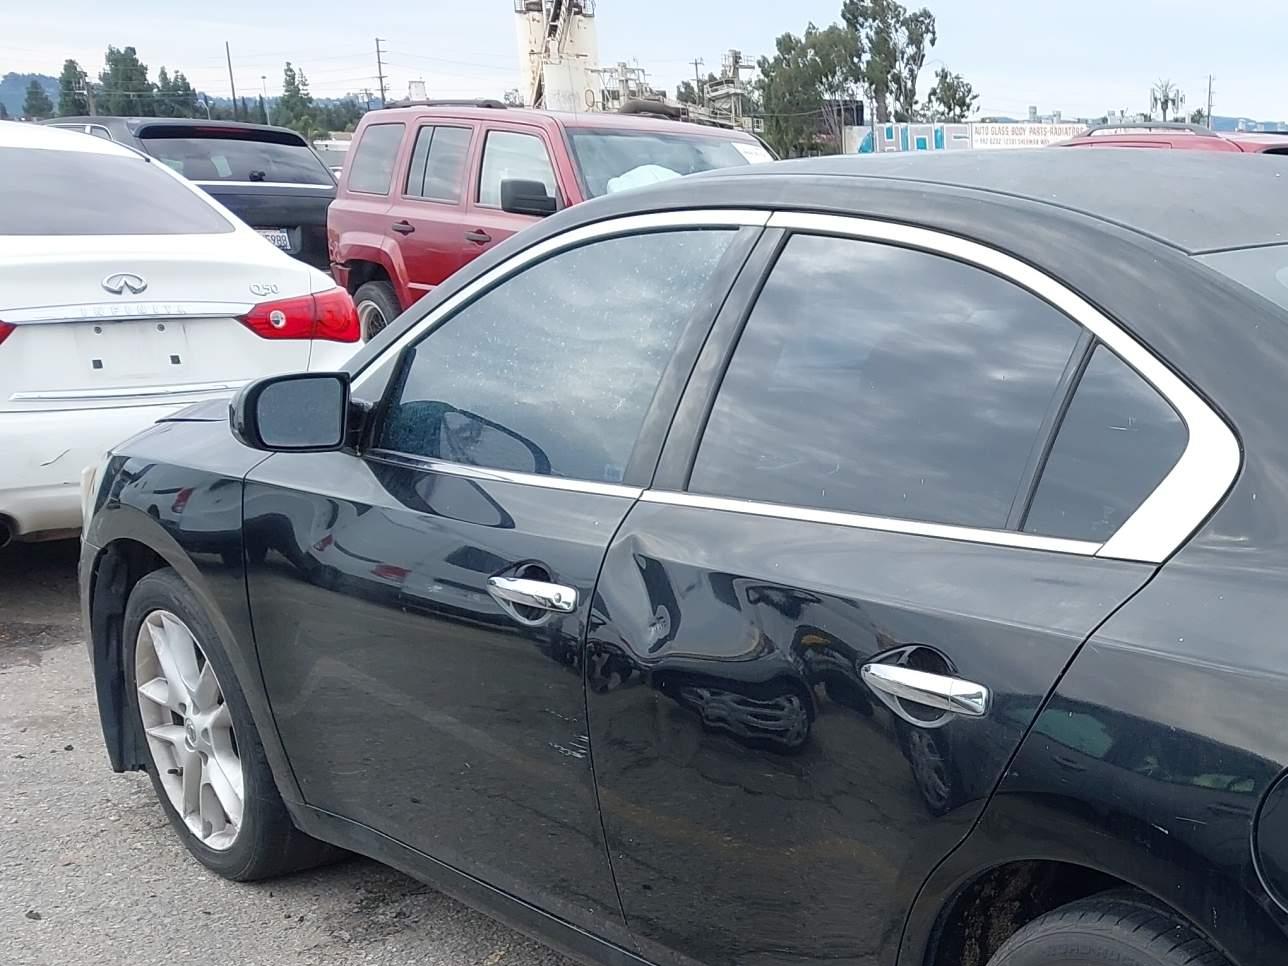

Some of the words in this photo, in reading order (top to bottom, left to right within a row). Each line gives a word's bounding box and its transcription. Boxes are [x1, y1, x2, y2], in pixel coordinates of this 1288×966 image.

[974, 126, 989, 136] AUTO
[991, 126, 1009, 136] GLASS
[1011, 126, 1026, 137] BODY
[249, 282, 279, 297] Q50
